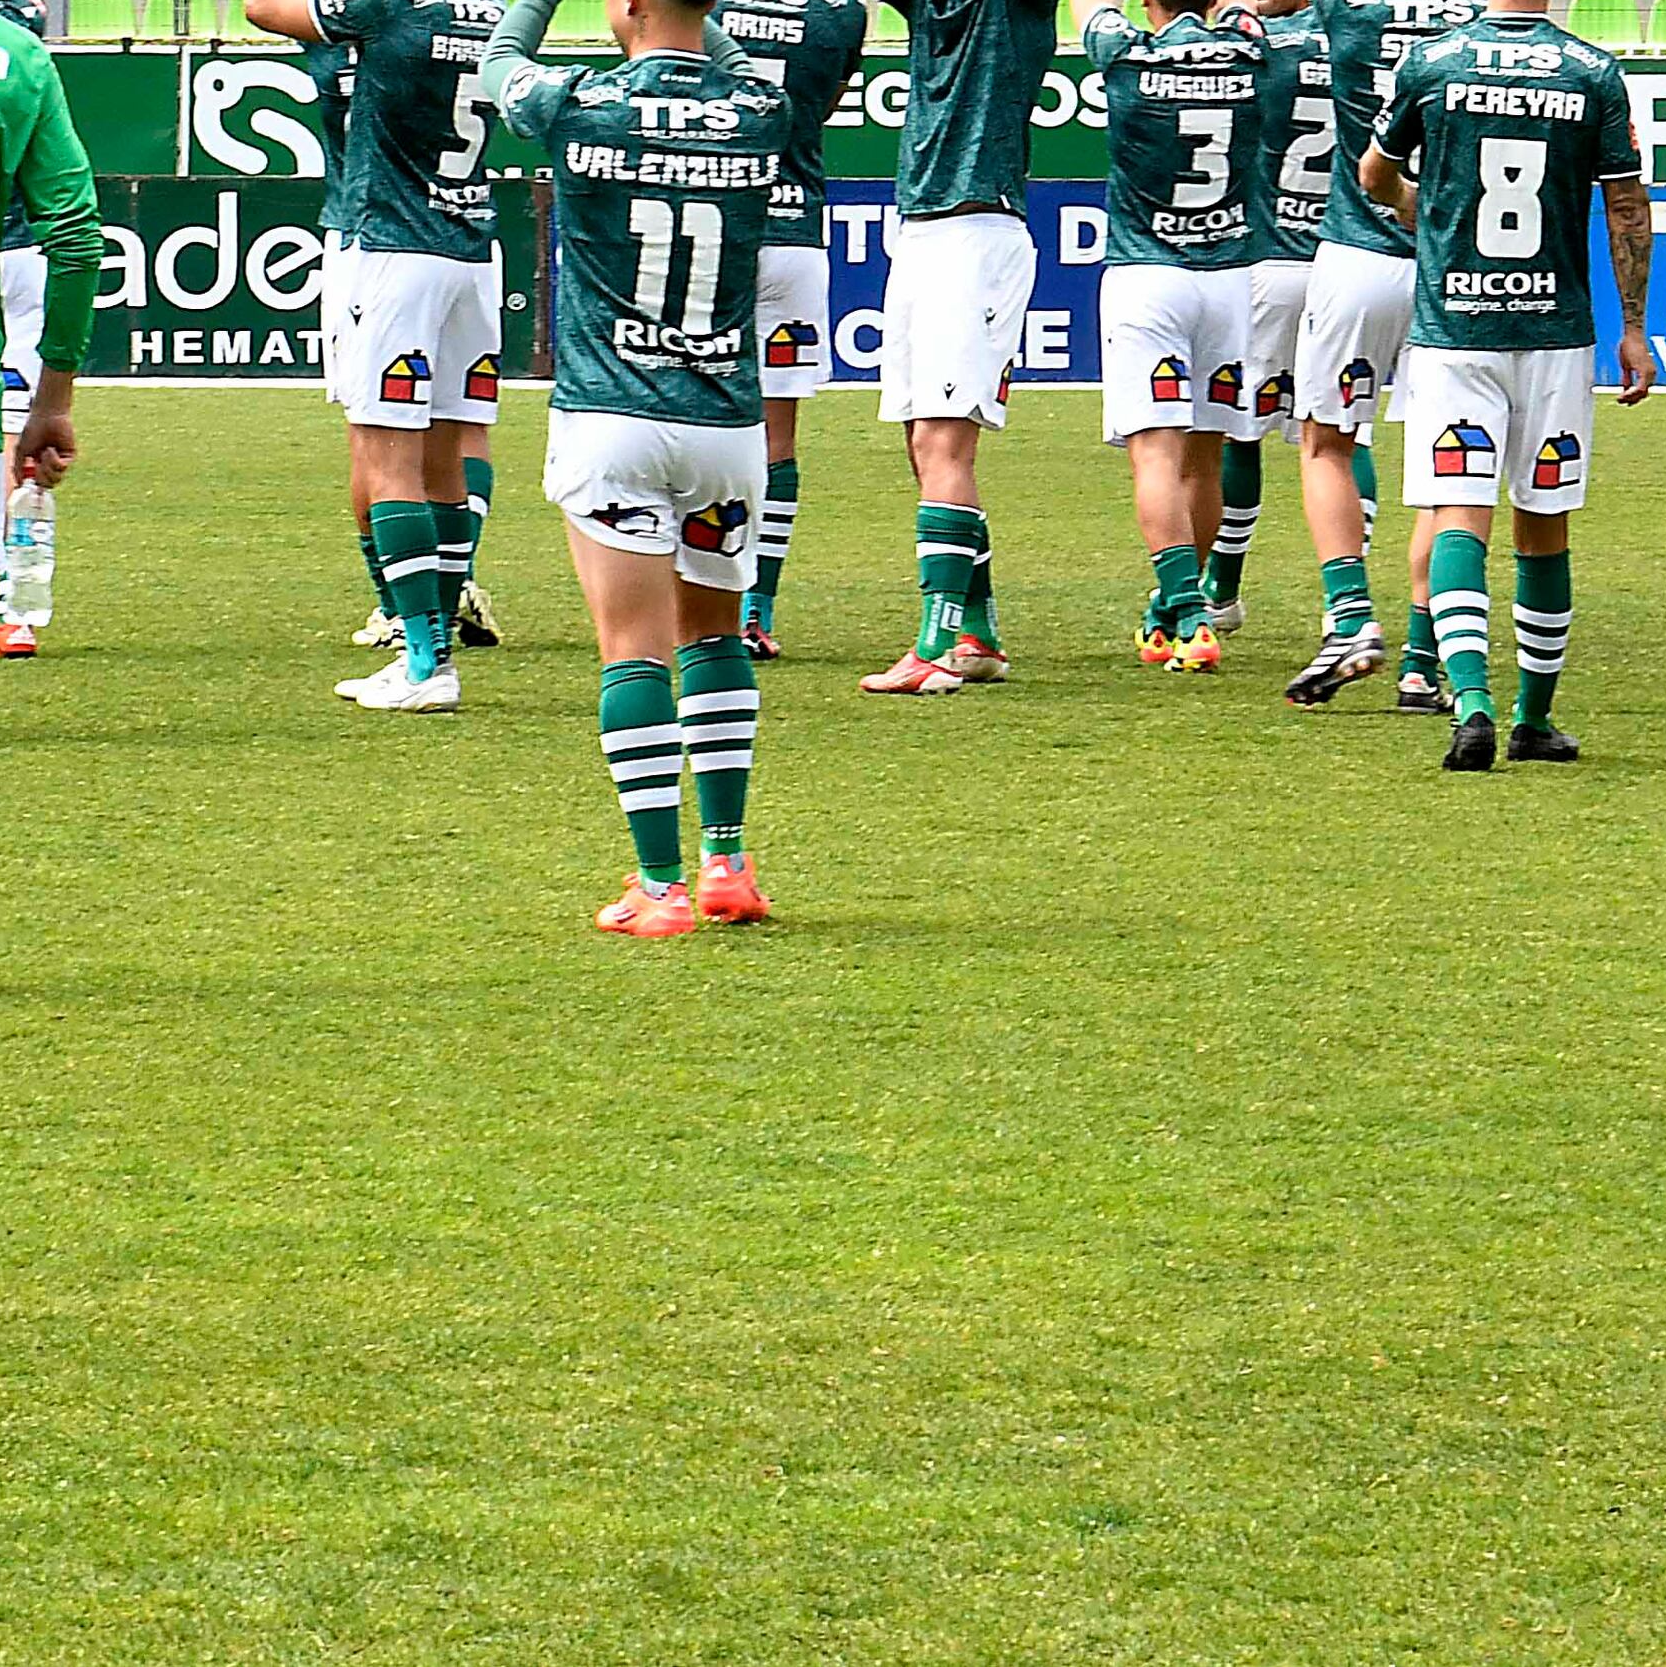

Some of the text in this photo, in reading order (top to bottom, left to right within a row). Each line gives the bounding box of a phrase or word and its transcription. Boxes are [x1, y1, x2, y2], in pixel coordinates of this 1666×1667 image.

[721, 11, 806, 44] ARIAS
[1166, 41, 1238, 63] TPS
[1467, 40, 1563, 70] TPS
[628, 97, 741, 131] TPS
[1445, 82, 1586, 122] PEREYRA
[438, 72, 489, 179] 5
[1171, 109, 1233, 208] 3
[1276, 196, 1327, 221] RIC
[1476, 138, 1548, 259] 8
[1151, 203, 1246, 232] RICOH
[629, 199, 723, 336] 11
[1446, 271, 1557, 296] RICOH
[613, 317, 742, 357] RICOH
